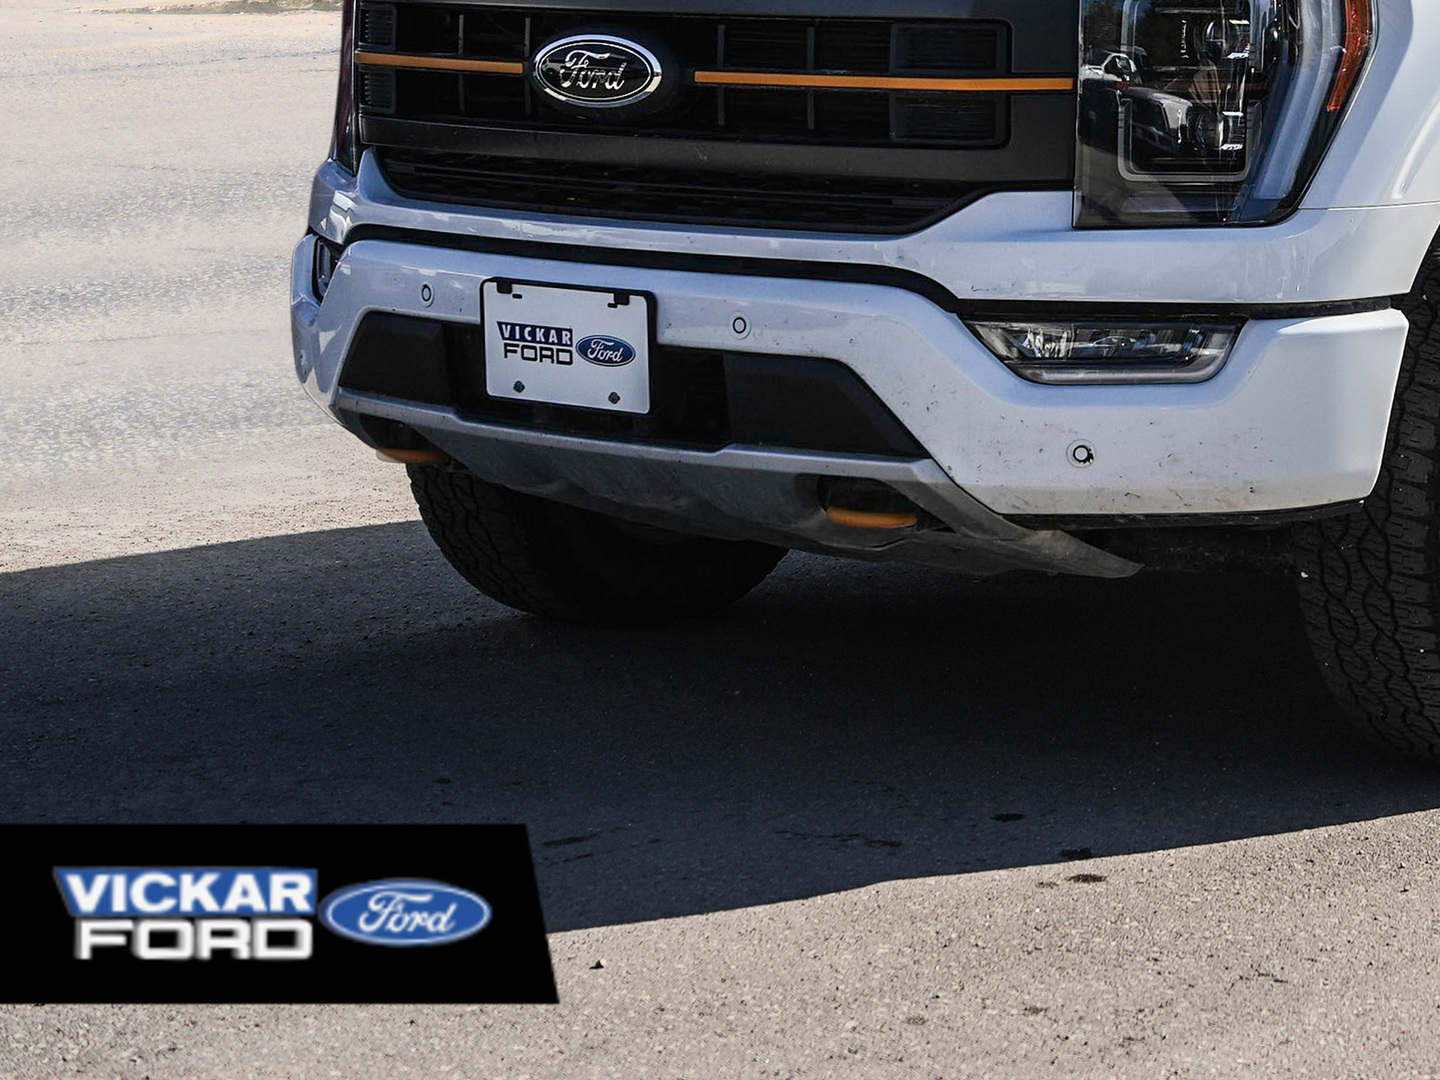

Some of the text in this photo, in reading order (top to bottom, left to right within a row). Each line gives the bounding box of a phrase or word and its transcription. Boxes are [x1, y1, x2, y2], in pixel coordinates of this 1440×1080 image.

[559, 49, 627, 90] Ford
[501, 324, 572, 346] VICKAR
[503, 342, 574, 366] FORD
[587, 338, 624, 362] Ford
